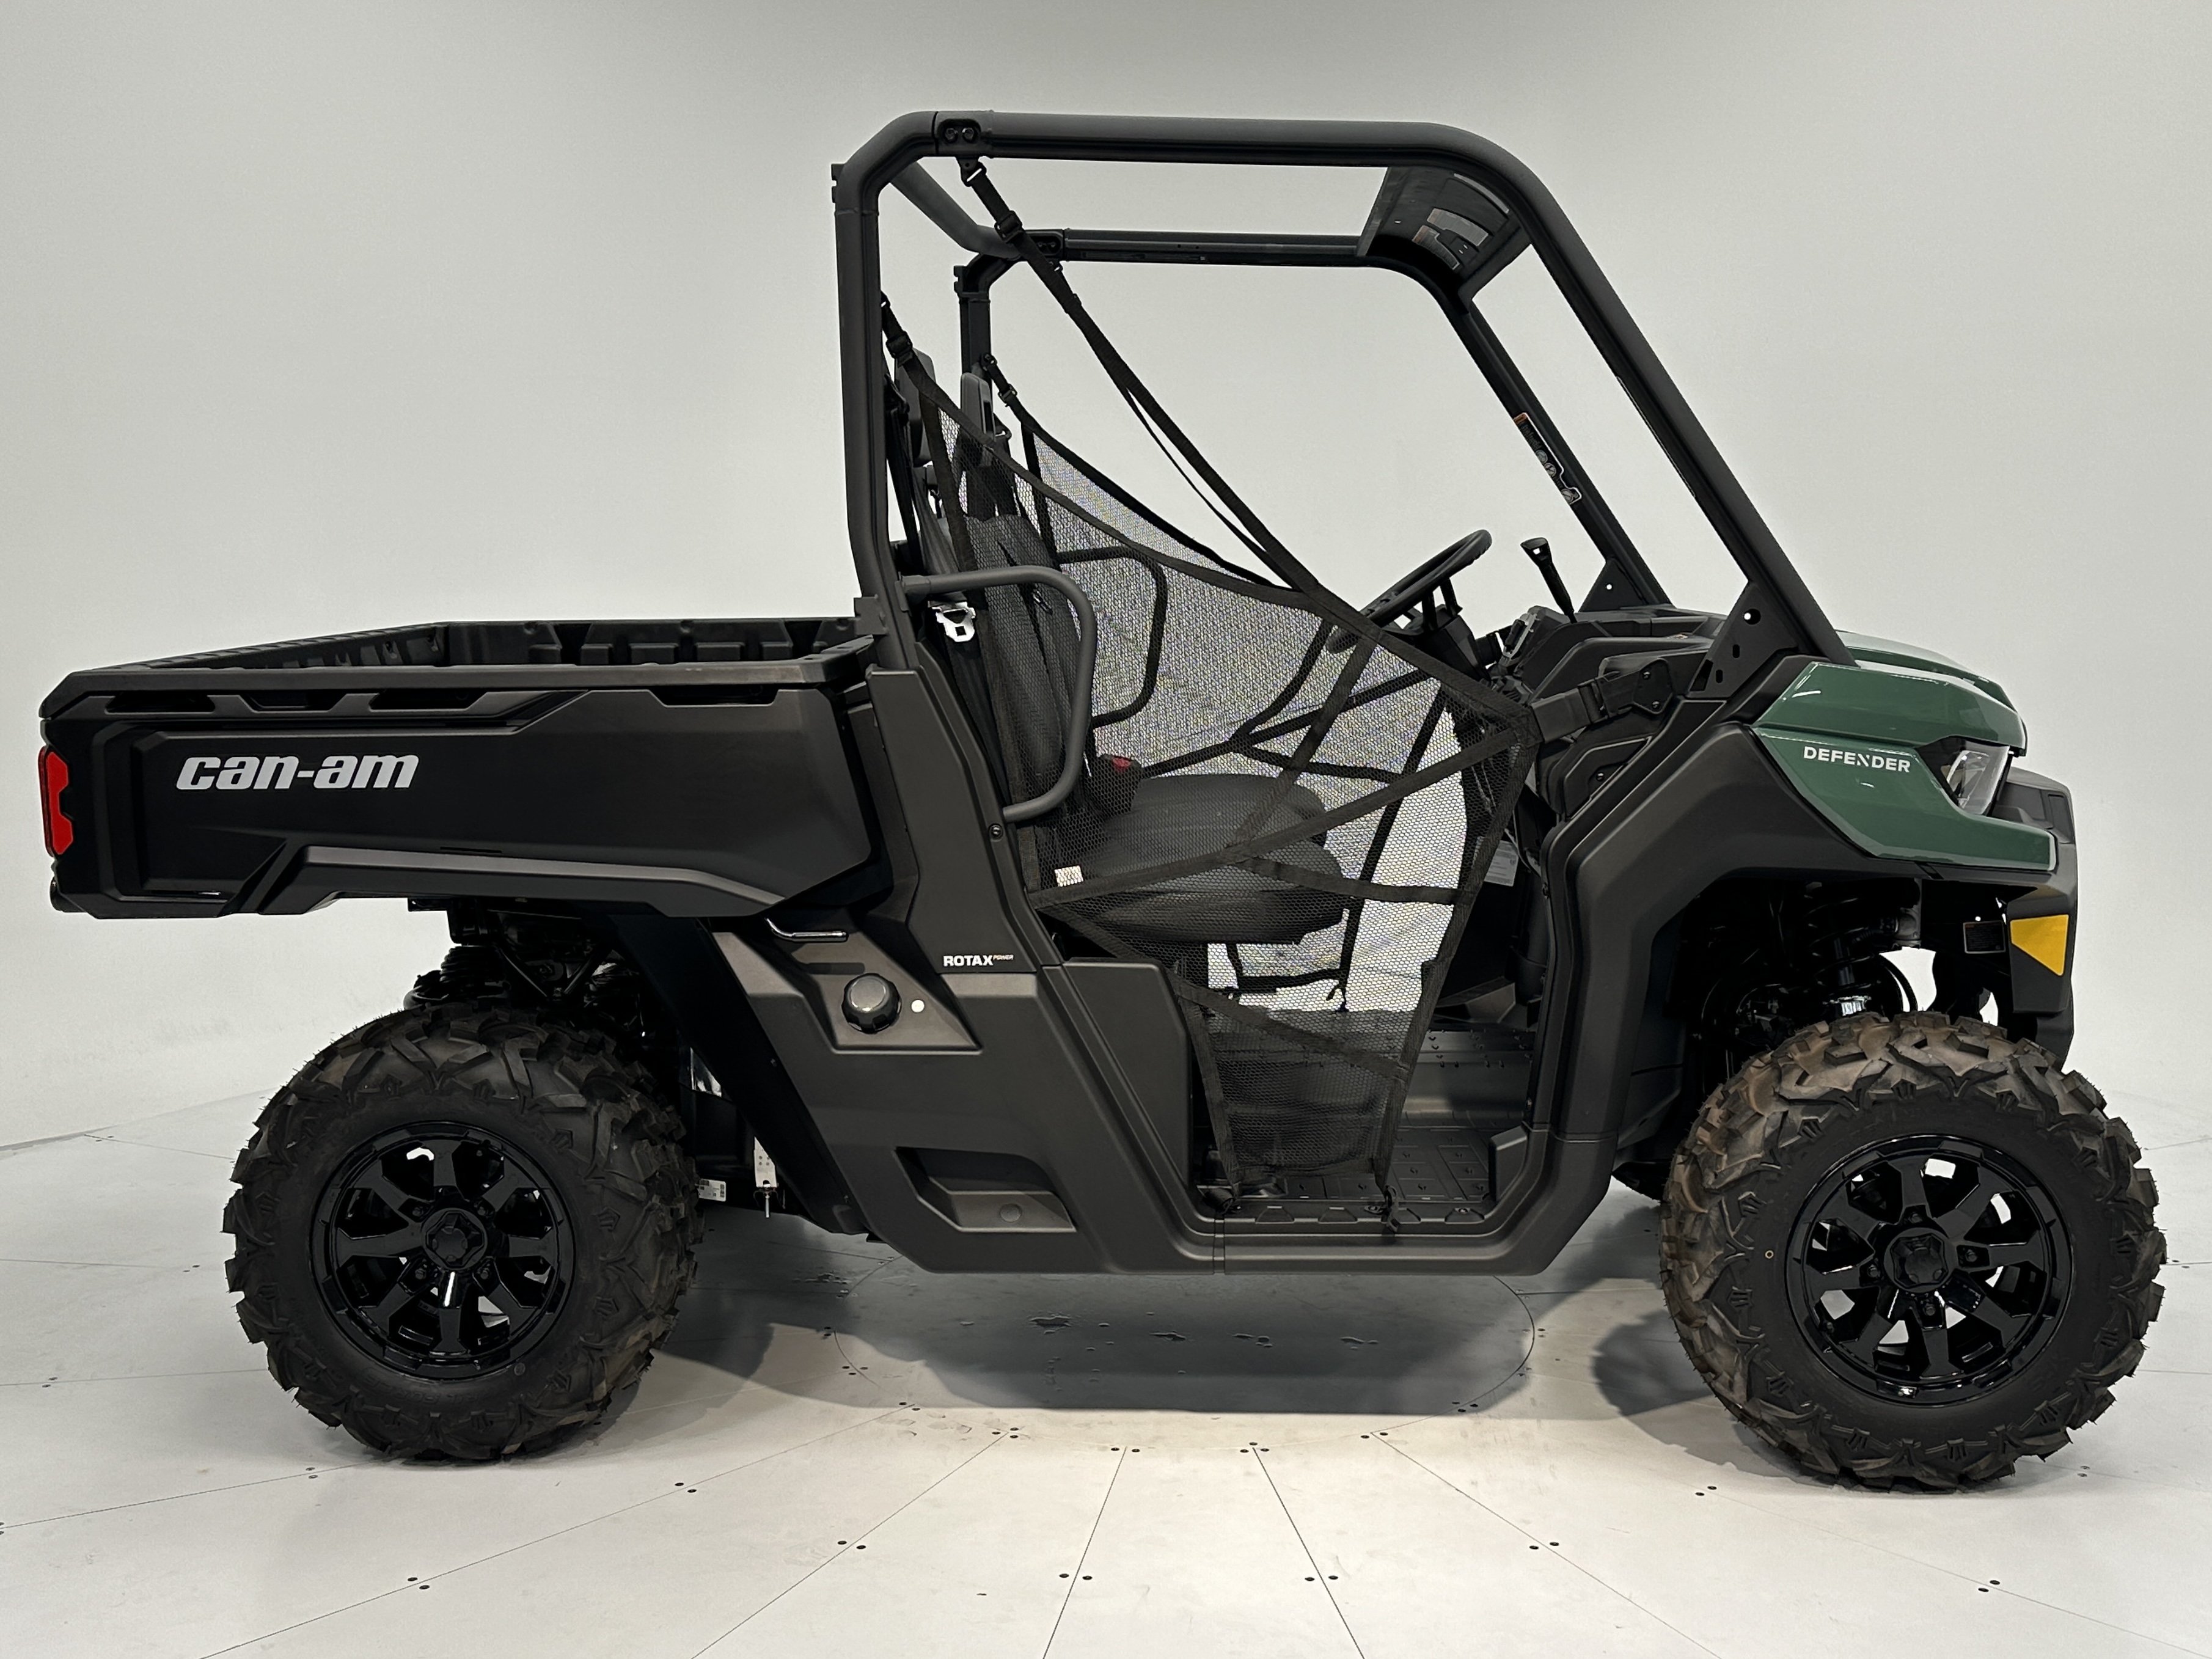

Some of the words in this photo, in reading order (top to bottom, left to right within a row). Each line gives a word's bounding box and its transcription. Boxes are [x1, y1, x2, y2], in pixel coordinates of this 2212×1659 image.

[176, 755, 420, 790] can-am
[1803, 745, 1911, 773] DEFENDER
[943, 954, 994, 967] ROTAX
